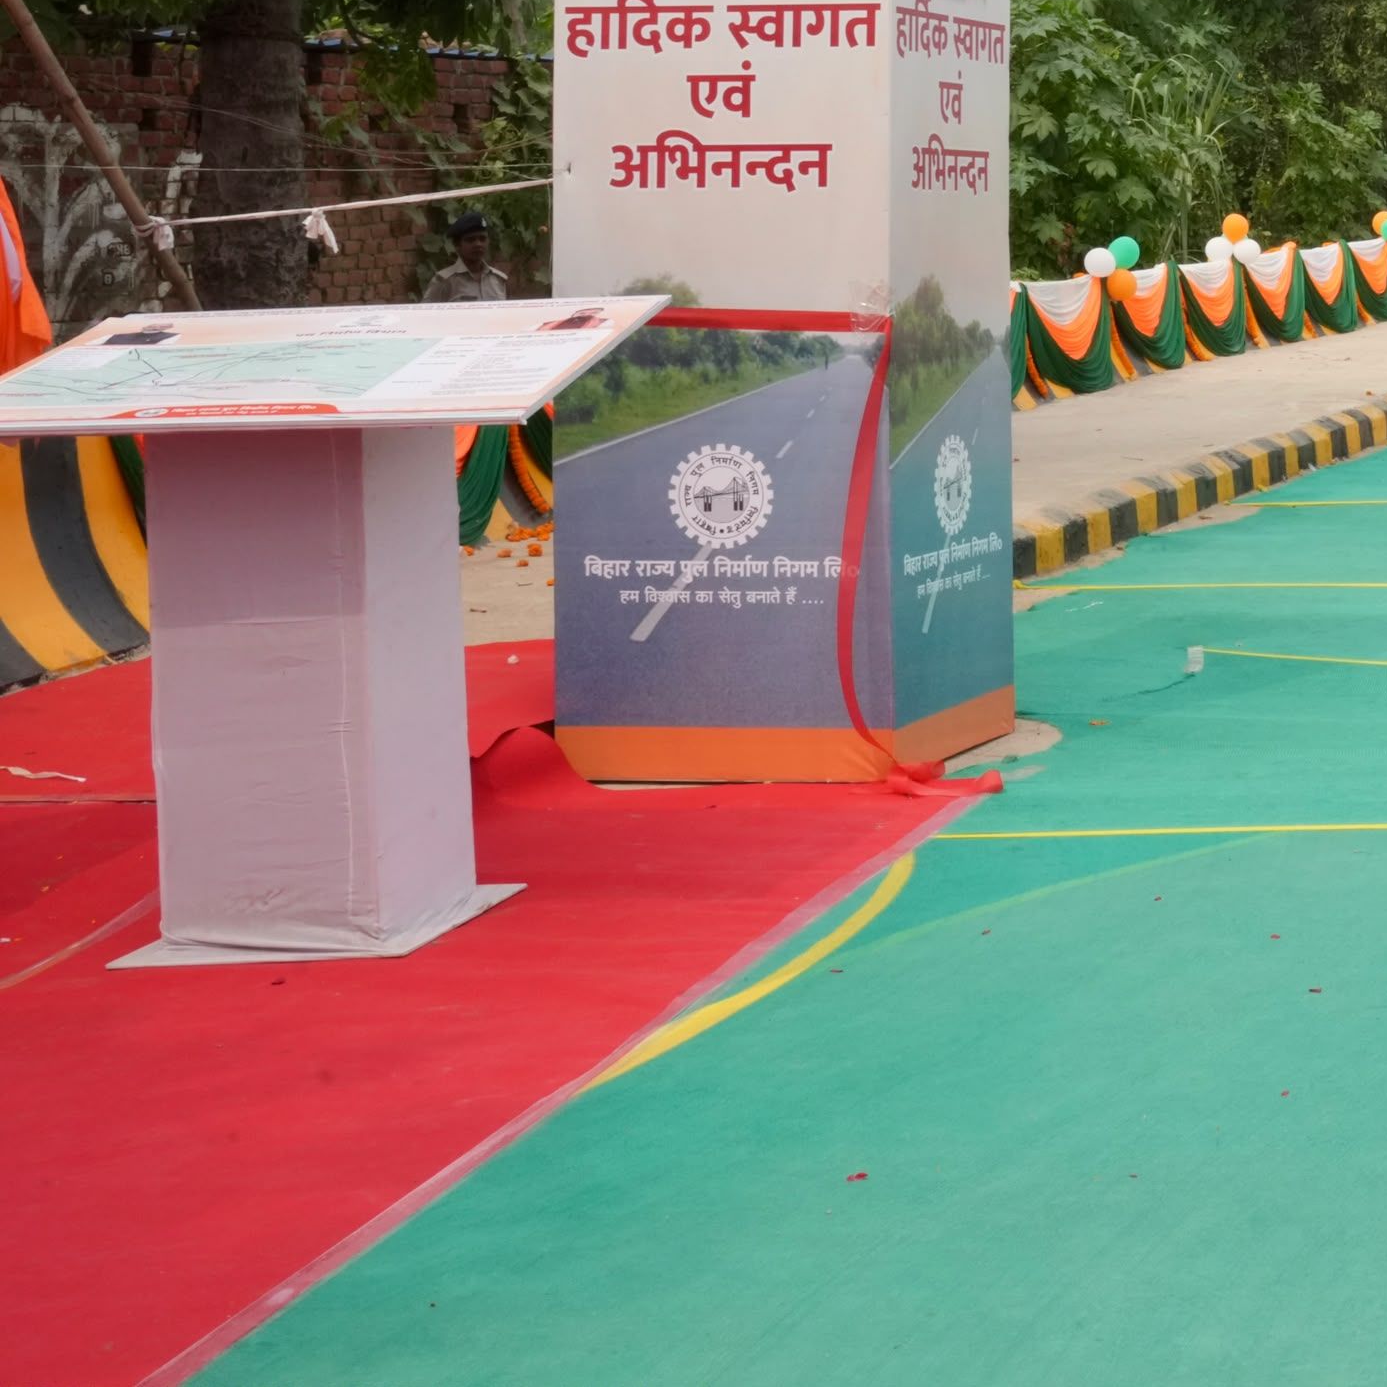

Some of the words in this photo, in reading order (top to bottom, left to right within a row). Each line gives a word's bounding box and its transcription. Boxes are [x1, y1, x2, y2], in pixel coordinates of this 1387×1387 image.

[727, 3, 880, 49] स्वागत
[953, 16, 1005, 64] स्वागत
[687, 60, 756, 119] एवं
[939, 70, 963, 125] एवं
[609, 129, 832, 193] अभिनन्दन
[911, 133, 989, 196] अभिनन्दन
[584, 555, 631, 579] बिहार
[635, 560, 676, 577] राज्य
[679, 560, 709, 583] पुल
[713, 555, 769, 578] निर्माण
[772, 555, 819, 578] निगम
[619, 590, 640, 604] हम
[695, 590, 714, 603] का
[717, 586, 742, 609] सेतु
[745, 586, 781, 604] बनाते
